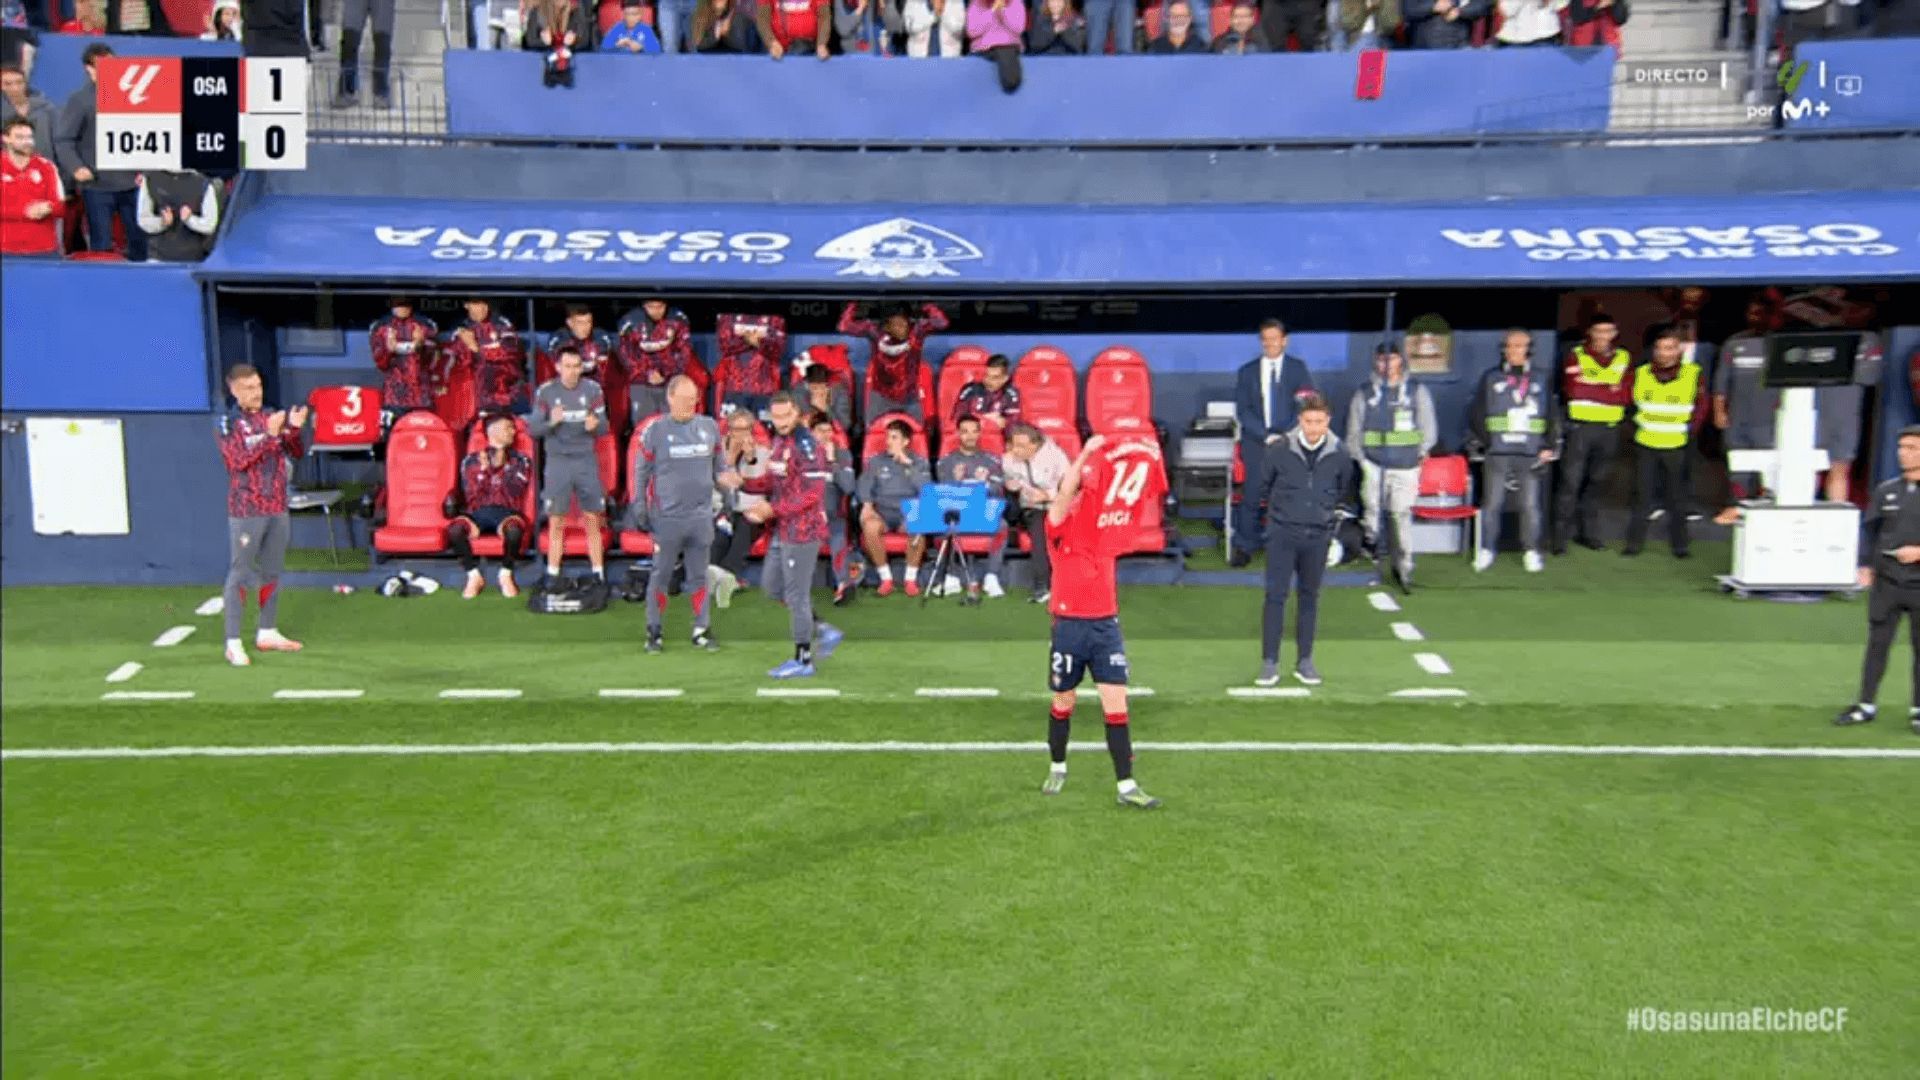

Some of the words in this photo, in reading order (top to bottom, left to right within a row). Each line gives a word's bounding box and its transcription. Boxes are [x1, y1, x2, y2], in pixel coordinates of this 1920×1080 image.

[374, 226, 791, 251] OSASUNA
[1439, 223, 1882, 248] OSASUNA
[668, 250, 785, 263] CLUB
[1766, 244, 1899, 257] CLUB
[341, 386, 363, 418] 3
[1103, 460, 1149, 507] 14
[1096, 510, 1131, 528] DIGI
[1052, 651, 1073, 674] 21
